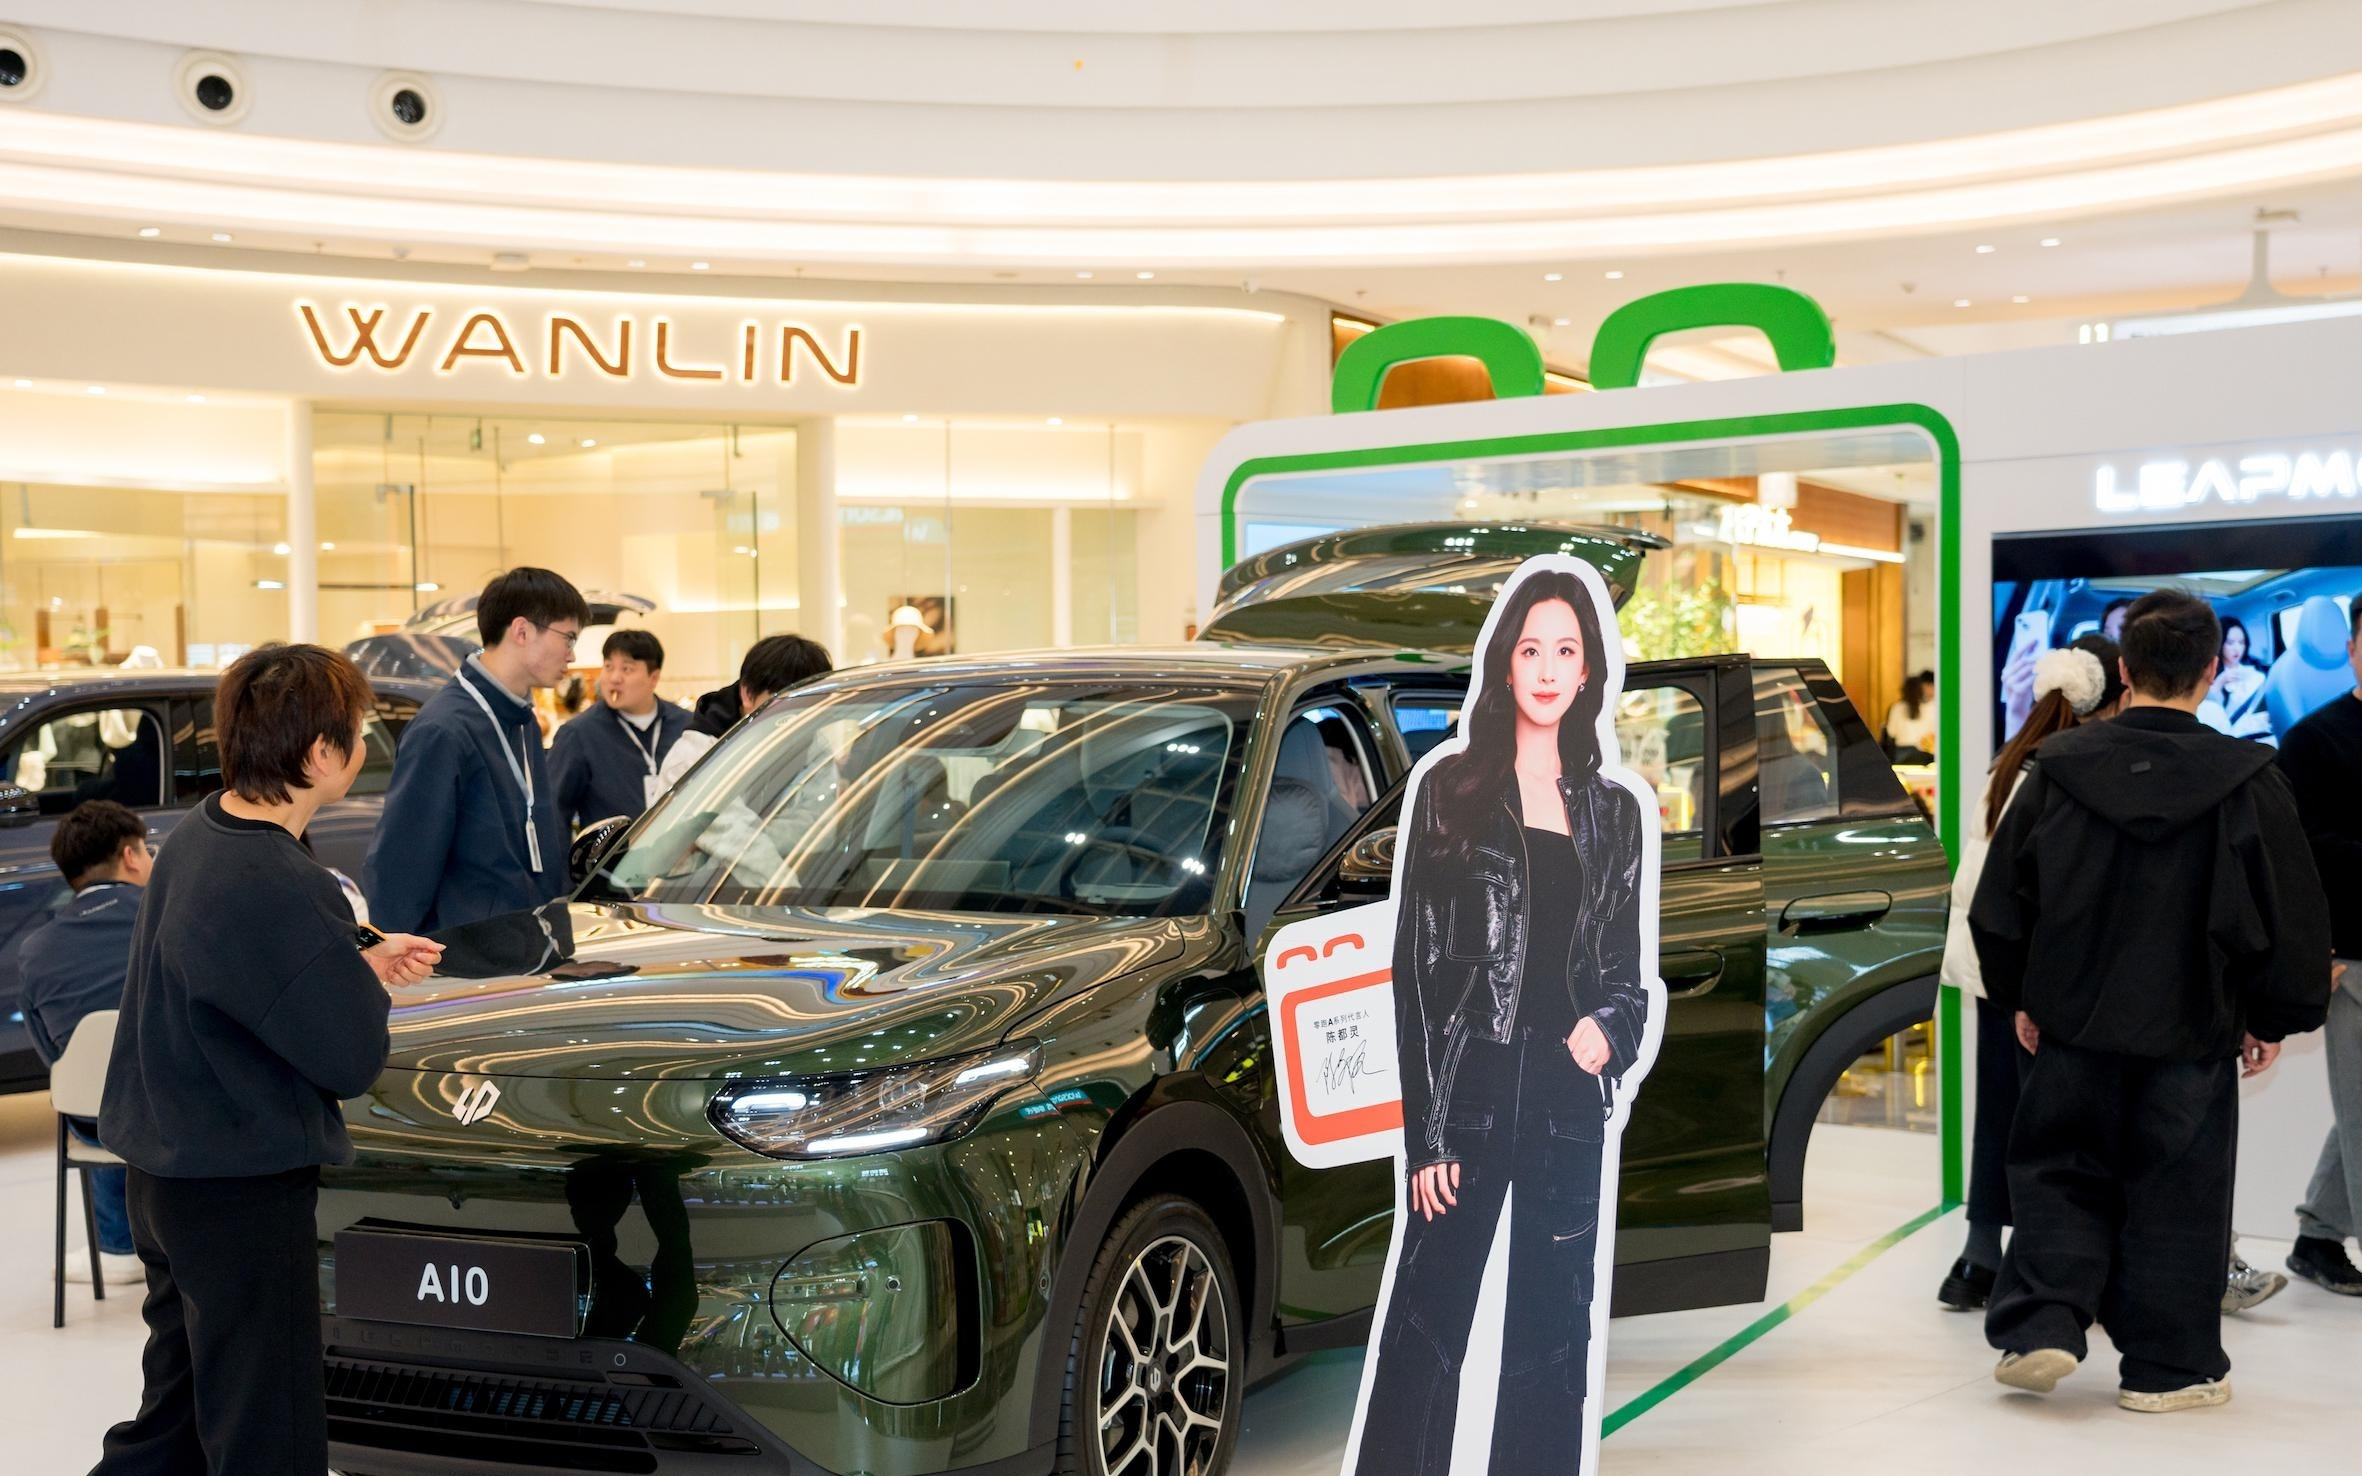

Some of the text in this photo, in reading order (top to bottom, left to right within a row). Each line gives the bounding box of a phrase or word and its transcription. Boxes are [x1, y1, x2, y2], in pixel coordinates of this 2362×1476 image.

[299, 304, 861, 386] WANLIN
[2095, 449, 2362, 512] LEAPM
[1325, 1024, 1360, 1044] 陈都灵
[416, 1261, 490, 1307] A10
